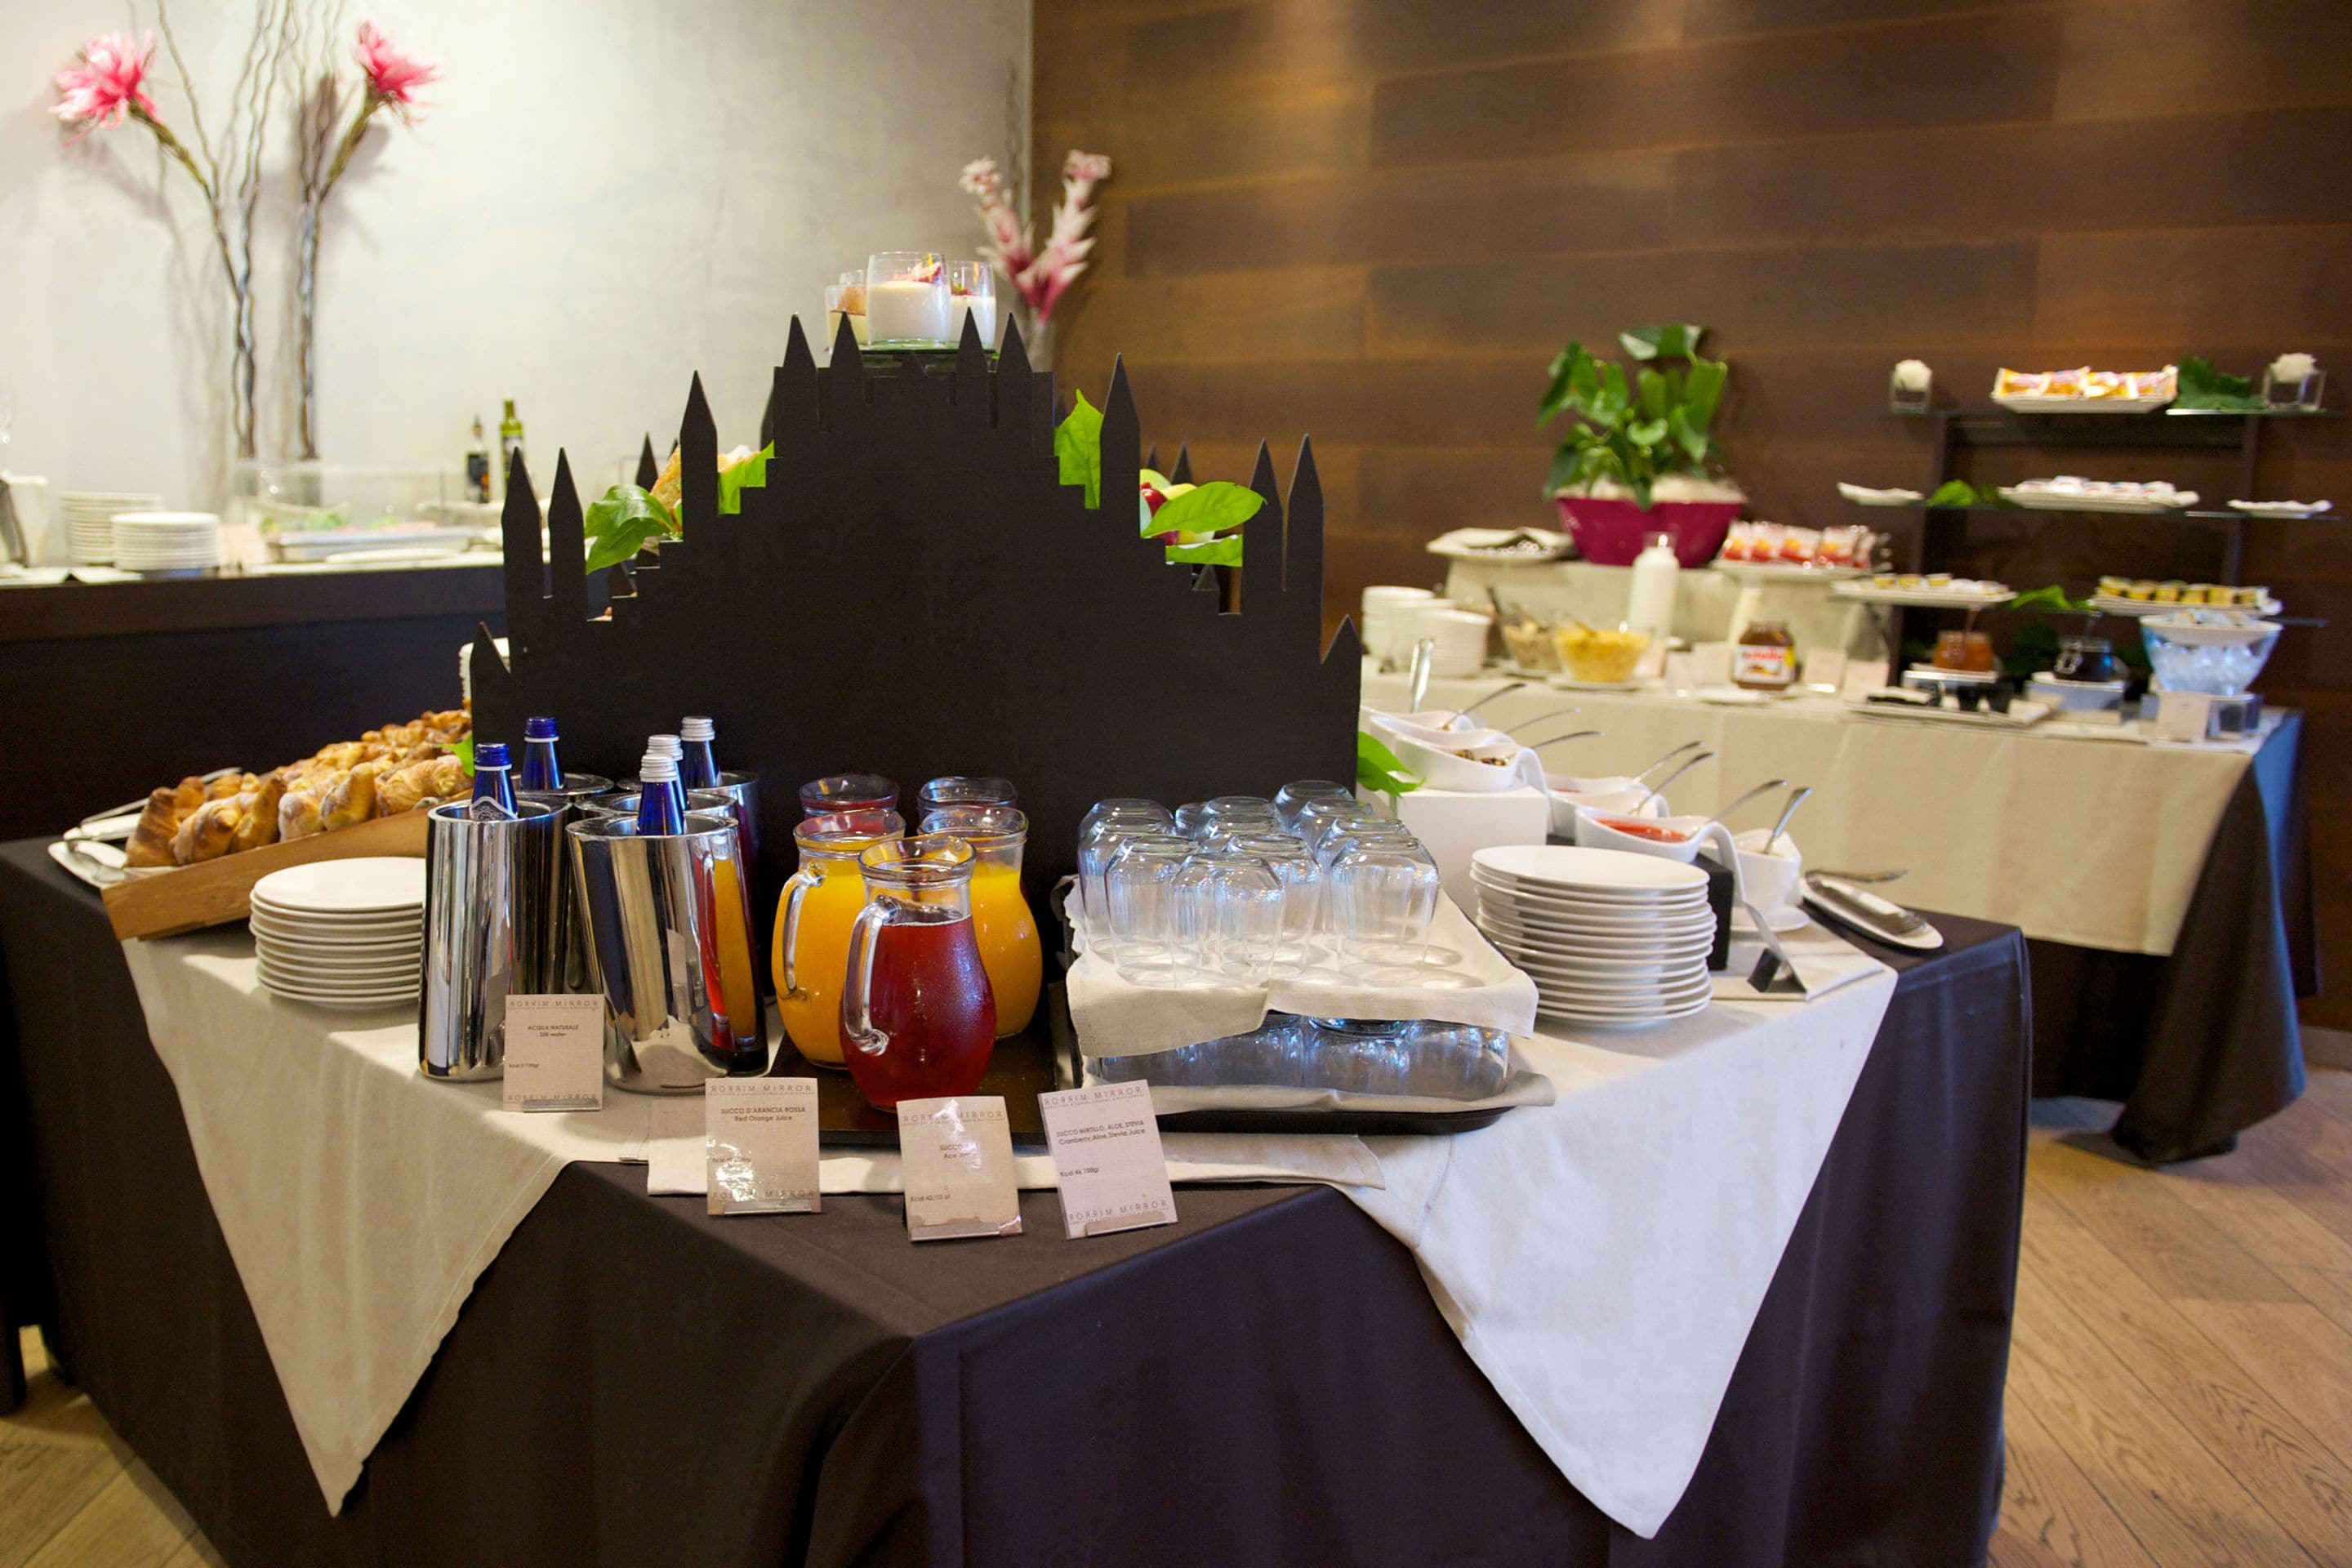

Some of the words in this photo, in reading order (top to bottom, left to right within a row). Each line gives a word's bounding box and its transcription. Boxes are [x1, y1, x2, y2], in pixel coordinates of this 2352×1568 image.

[1094, 1086, 1142, 1099] MIRROR
[1056, 1128, 1079, 1138] SUCCO
[1129, 1129, 1146, 1137] Juice
[1120, 1199, 1168, 1214] MIRROR
